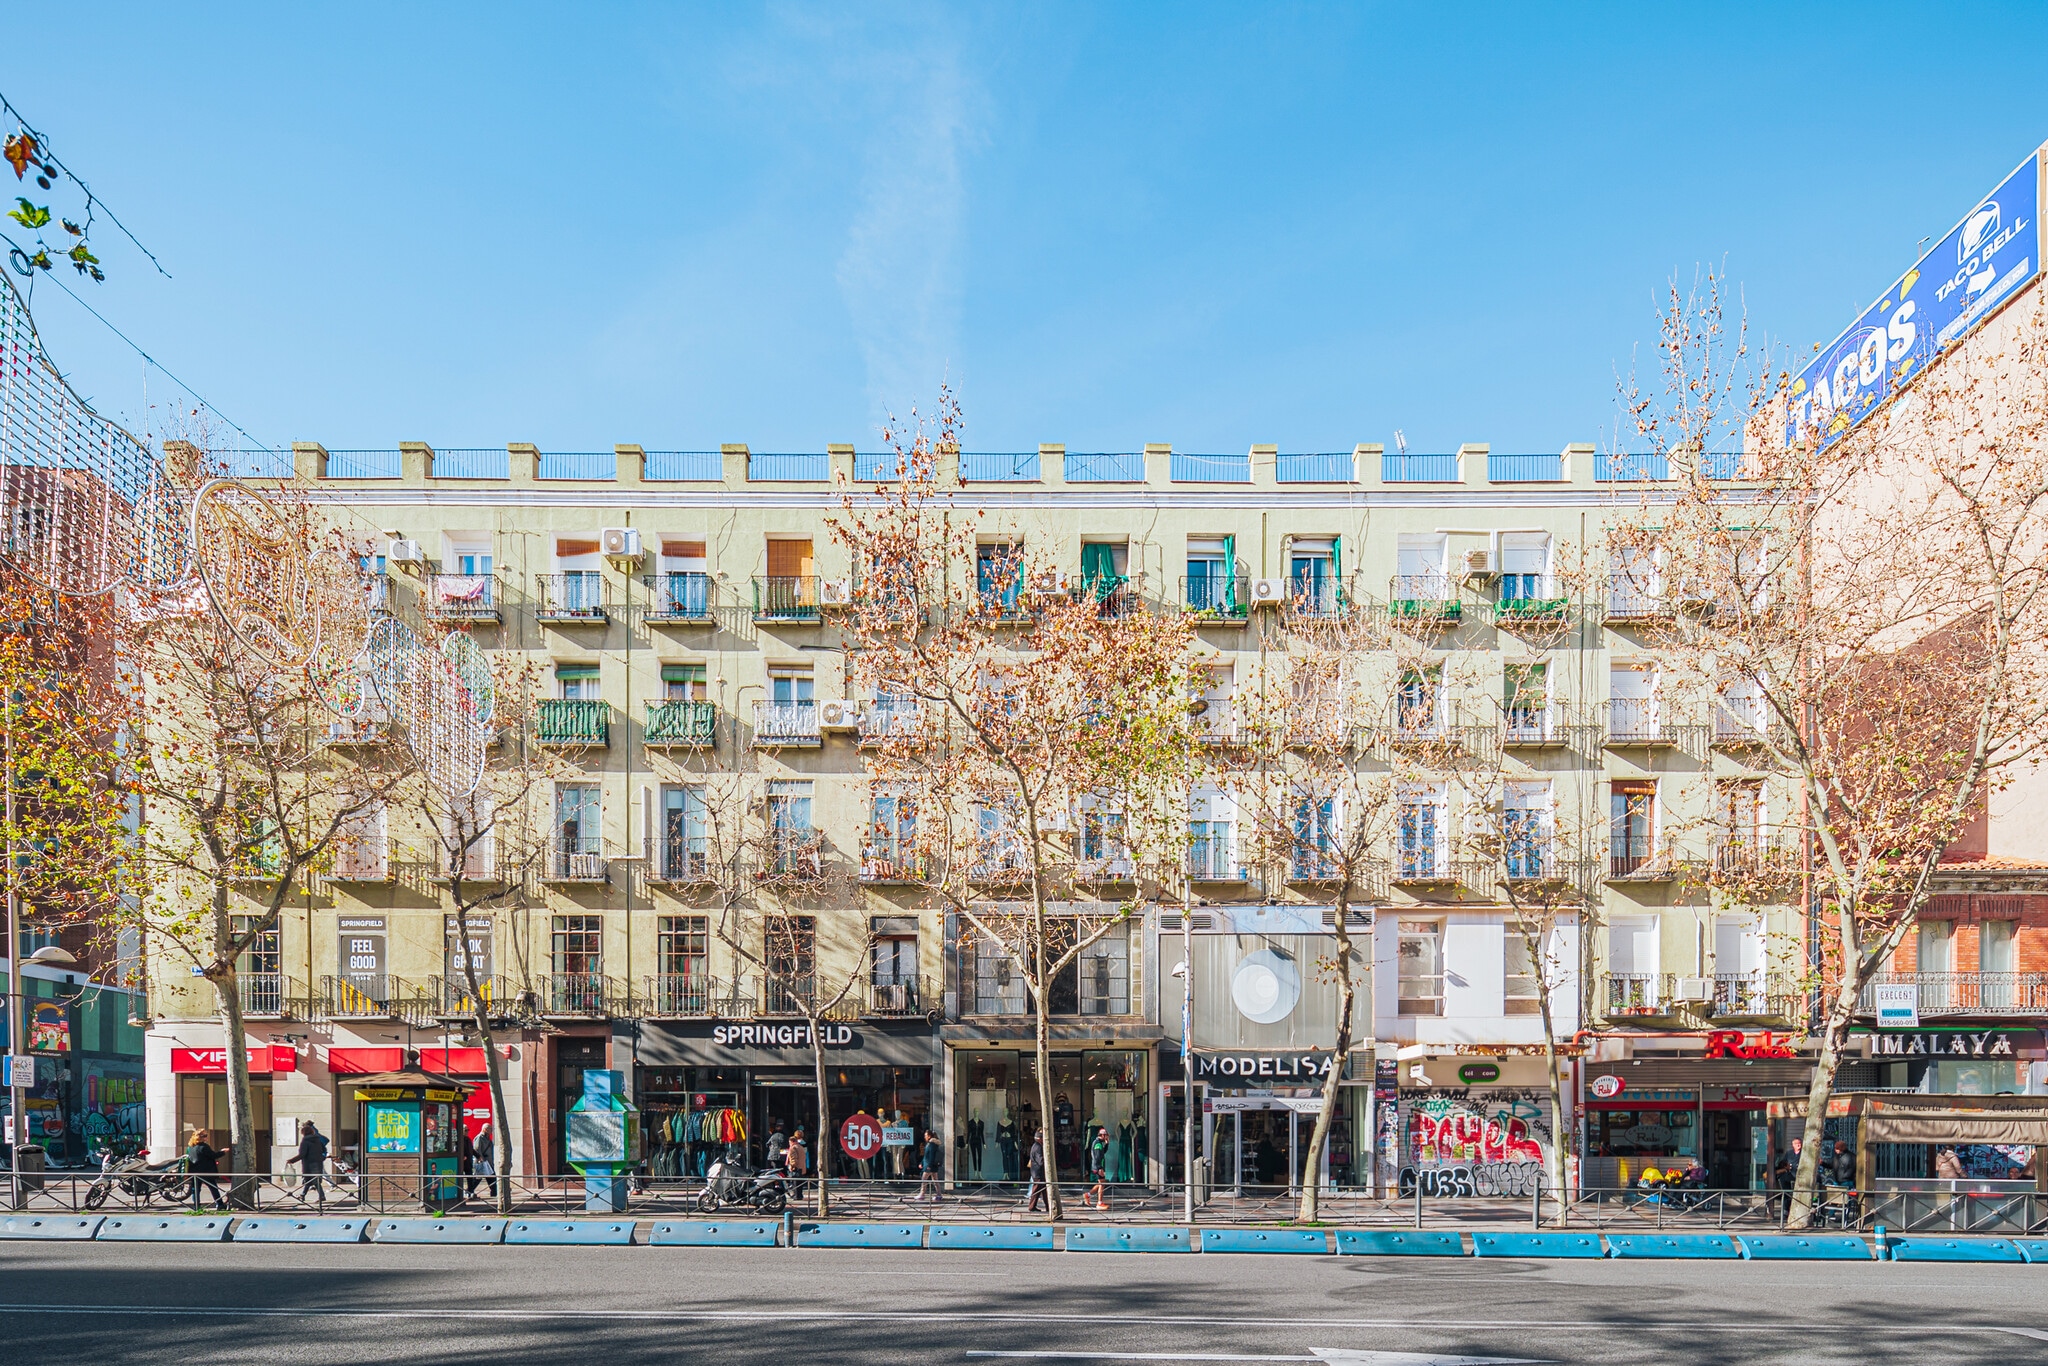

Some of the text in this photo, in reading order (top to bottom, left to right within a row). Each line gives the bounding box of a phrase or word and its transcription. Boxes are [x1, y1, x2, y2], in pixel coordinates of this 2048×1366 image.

[1935, 216, 2030, 302] TACO BELL
[1793, 300, 1916, 441] TACOS
[341, 919, 383, 927] SPRINGFIELD
[351, 939, 375, 953] FEEL
[457, 939, 482, 953] LOK
[350, 955, 376, 969] GOOD
[453, 955, 485, 969] GRAT
[1851, 1030, 2013, 1055] IMALAYA
[1199, 1056, 1334, 1076] MODELISA
[376, 1112, 409, 1125] BIEN
[373, 1125, 409, 1139] JUGADO
[843, 1125, 911, 1151] -50% REBAJAS
